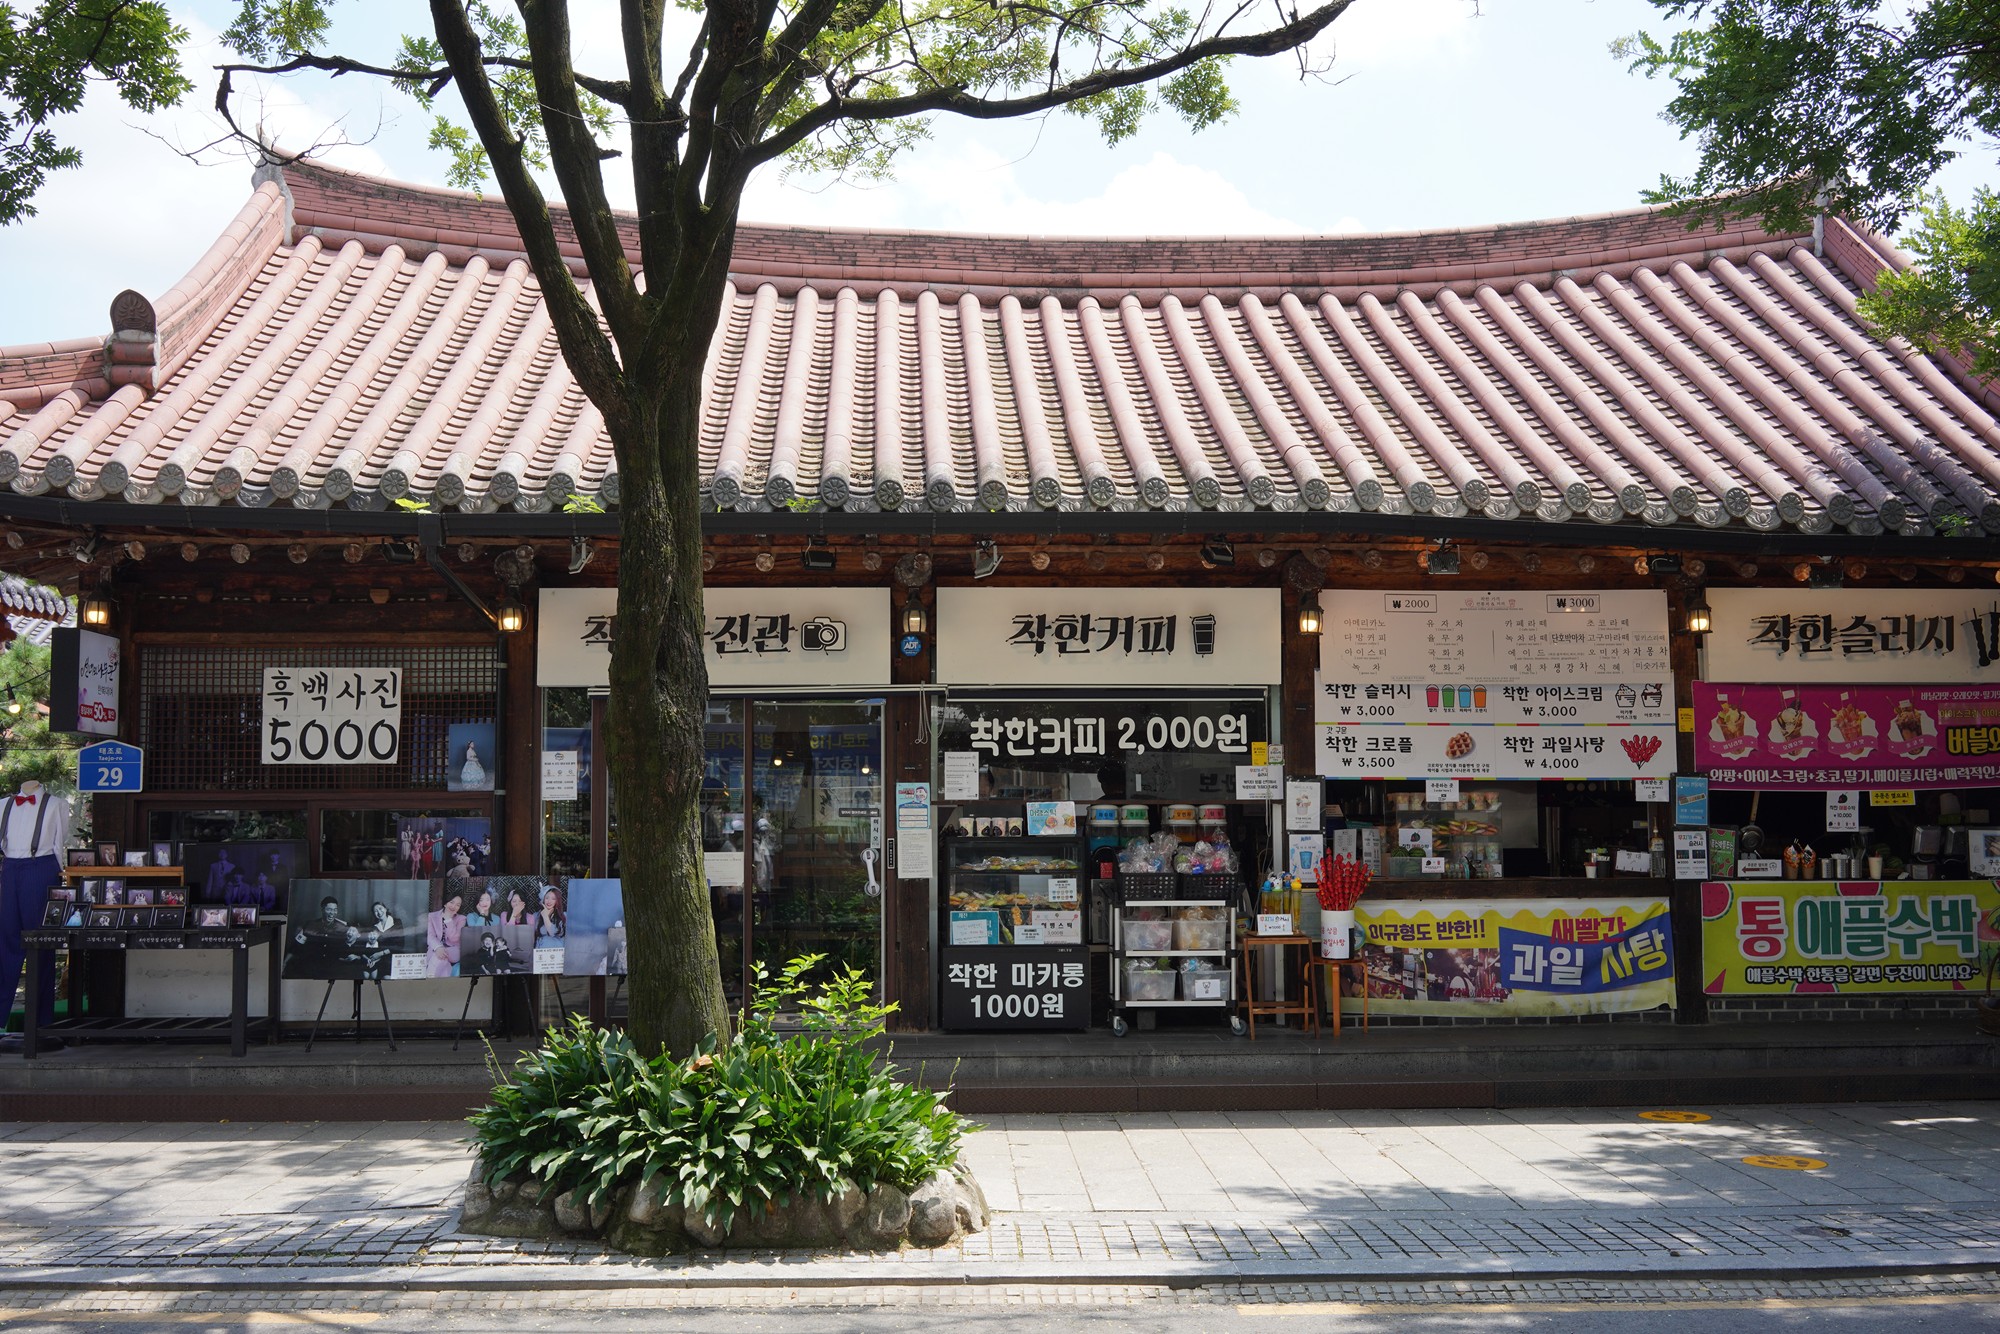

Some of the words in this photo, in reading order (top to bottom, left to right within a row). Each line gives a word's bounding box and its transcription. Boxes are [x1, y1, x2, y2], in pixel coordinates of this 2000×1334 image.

[1404, 599, 1430, 608] 2000
[1570, 597, 1594, 608] 3000
[1343, 618, 1386, 627] 아메리카노
[1426, 619, 1464, 628] 유자차
[1504, 618, 1548, 628] 카페라떼
[1586, 618, 1630, 627] 초코라떼
[1005, 613, 1177, 658] 착한커피
[1344, 633, 1387, 642] 다방커피
[1427, 634, 1464, 643] 율무차
[1505, 633, 1548, 642] 녹차라떼
[1587, 633, 1630, 642] 고구마라떼
[1747, 613, 1955, 657] 착한슬러시
[904, 641, 919, 649] ADT
[1344, 648, 1387, 657] 아이스티
[1427, 648, 1465, 657] 국화차
[1507, 648, 1546, 657] 에이드
[1588, 648, 1631, 656] 오미자차
[1633, 647, 1668, 656] 자몽차
[1351, 662, 1381, 672] 녹차
[1428, 662, 1466, 672] 쌍화차
[1509, 663, 1548, 672] 매실차
[1553, 661, 1589, 674] 생강차
[1597, 662, 1621, 672] 식혜
[267, 669, 398, 712] 흑백사진
[1325, 684, 1358, 699] 착한
[1364, 684, 1412, 699] 슬러시
[1503, 686, 1530, 702] 착한
[1535, 686, 1603, 702] 아이스크림
[1357, 705, 1395, 716] 3,000
[1538, 706, 1577, 717] 3,000
[268, 717, 397, 761] 5000
[970, 717, 1106, 757] 착한커피
[1117, 713, 1248, 755] 2,000원
[1325, 736, 1358, 753] 착한
[1365, 736, 1413, 753] 크로플
[1503, 736, 1535, 754] 착한
[1541, 736, 1606, 754] 과일사탕
[98, 747, 123, 755] 태조로
[1358, 758, 1395, 768] 3,500
[1541, 758, 1579, 769] 4,000
[97, 767, 123, 787] 29
[1369, 922, 1432, 942] 이규형도
[1436, 918, 1486, 939] 반한!!
[1550, 915, 1628, 944] 새빨간
[1739, 899, 1786, 958] 통
[1796, 897, 1979, 958] 애플수박
[1600, 927, 1668, 984] 사탕
[1509, 943, 1585, 986] 과일
[948, 962, 998, 989] 착한
[1011, 962, 1085, 989] 마카롱
[1745, 966, 1805, 983] 애플수박
[1806, 967, 1850, 983] 한통을
[1851, 967, 1882, 982] 갈면
[1884, 967, 1927, 982] 두잔이
[1929, 965, 1980, 981] 나와요~
[970, 993, 1064, 1019] 1000원
